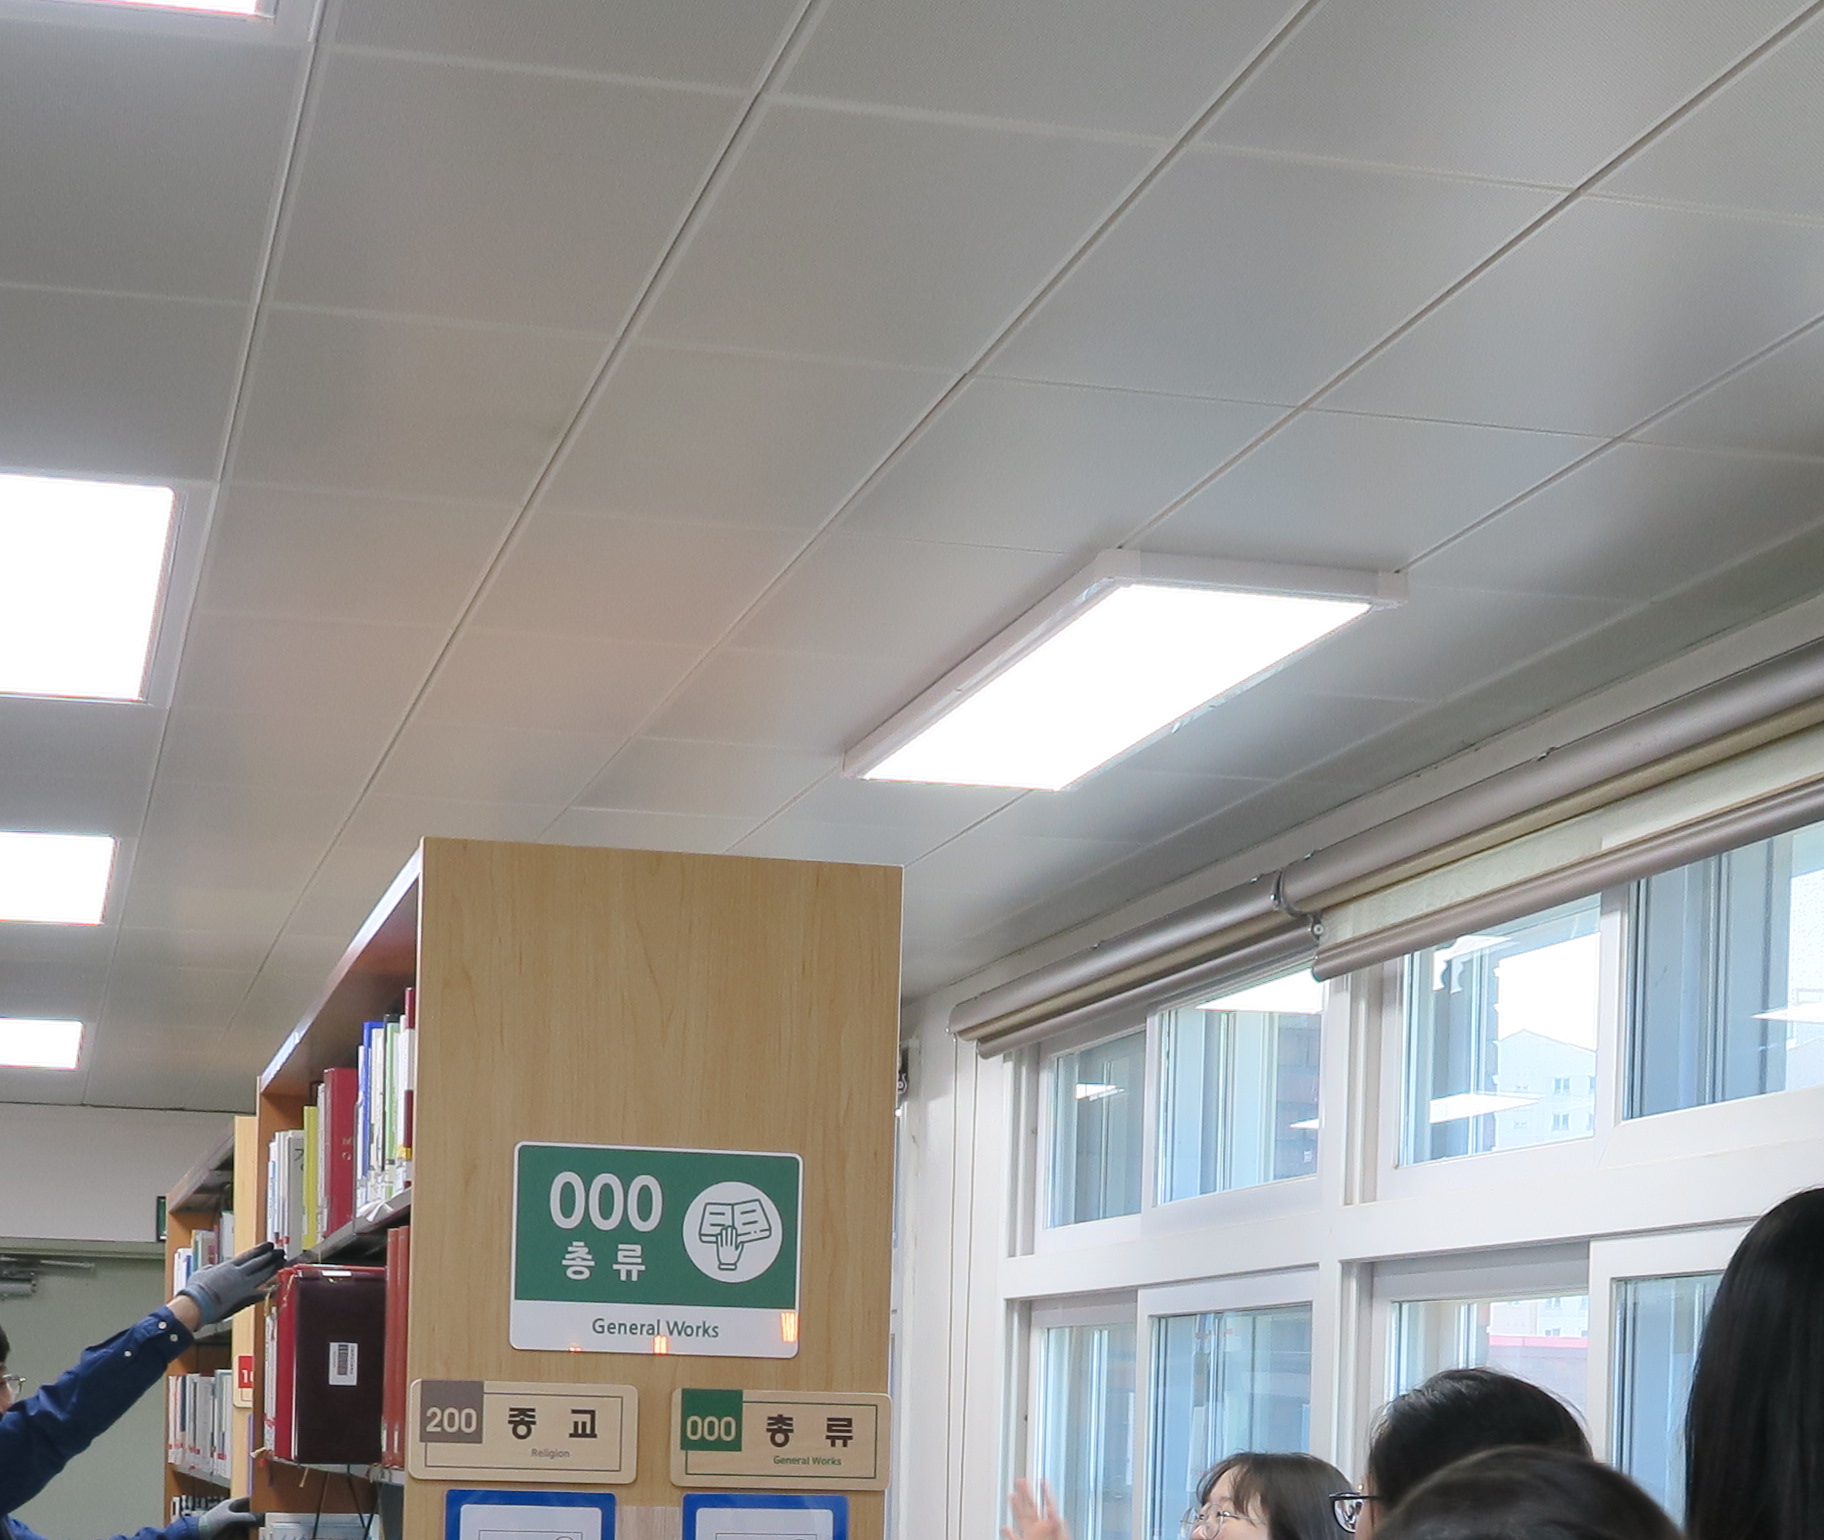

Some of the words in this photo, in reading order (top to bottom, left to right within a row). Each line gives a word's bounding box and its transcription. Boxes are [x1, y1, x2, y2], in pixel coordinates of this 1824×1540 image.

[549, 1170, 664, 1233] 000
[592, 1317, 661, 1339] General
[665, 1320, 720, 1340] Works
[425, 1407, 478, 1434] 200
[686, 1416, 737, 1442] 000
[530, 1447, 571, 1460] Religion
[773, 1454, 810, 1466] General
[812, 1456, 842, 1467] Works
